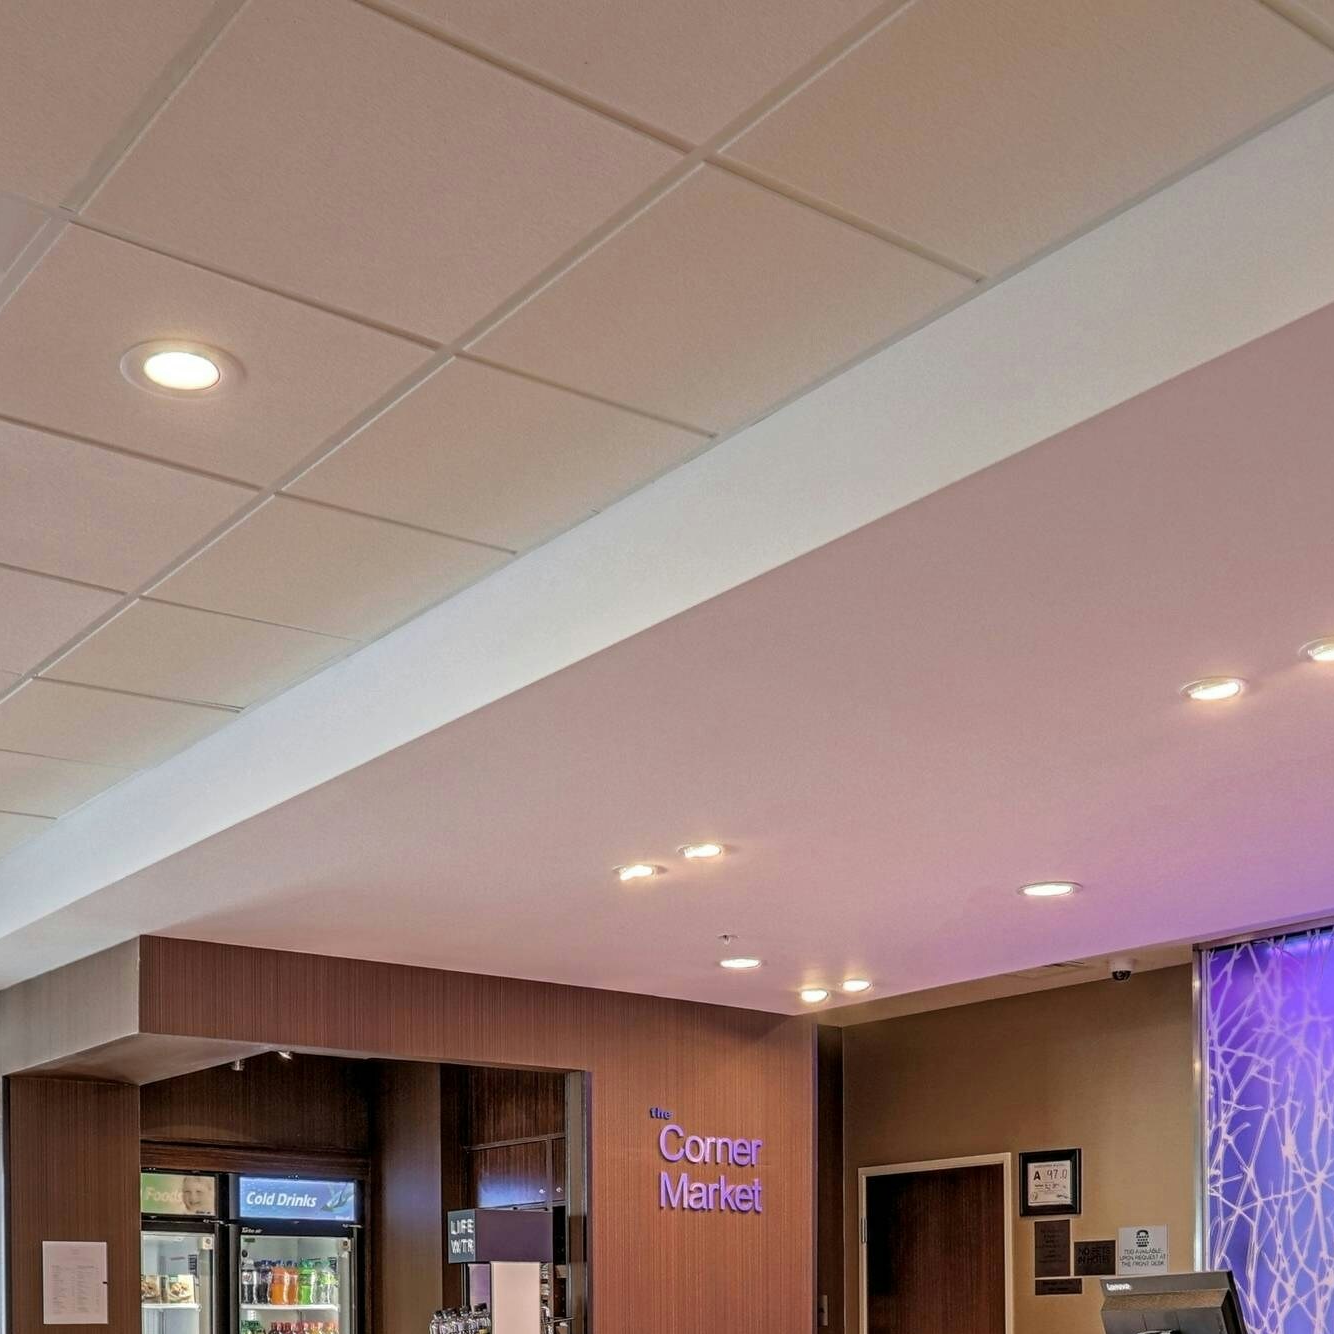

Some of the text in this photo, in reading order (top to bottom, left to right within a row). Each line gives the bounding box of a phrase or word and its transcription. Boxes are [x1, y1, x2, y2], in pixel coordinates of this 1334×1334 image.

[650, 1107, 672, 1120] the
[659, 1124, 763, 1167] Corner
[1033, 1170, 1041, 1181] A
[247, 1191, 317, 1208] Cold Drinks
[659, 1170, 763, 1213] Market
[450, 1218, 475, 1235] LIFE
[450, 1238, 475, 1254] WTR
